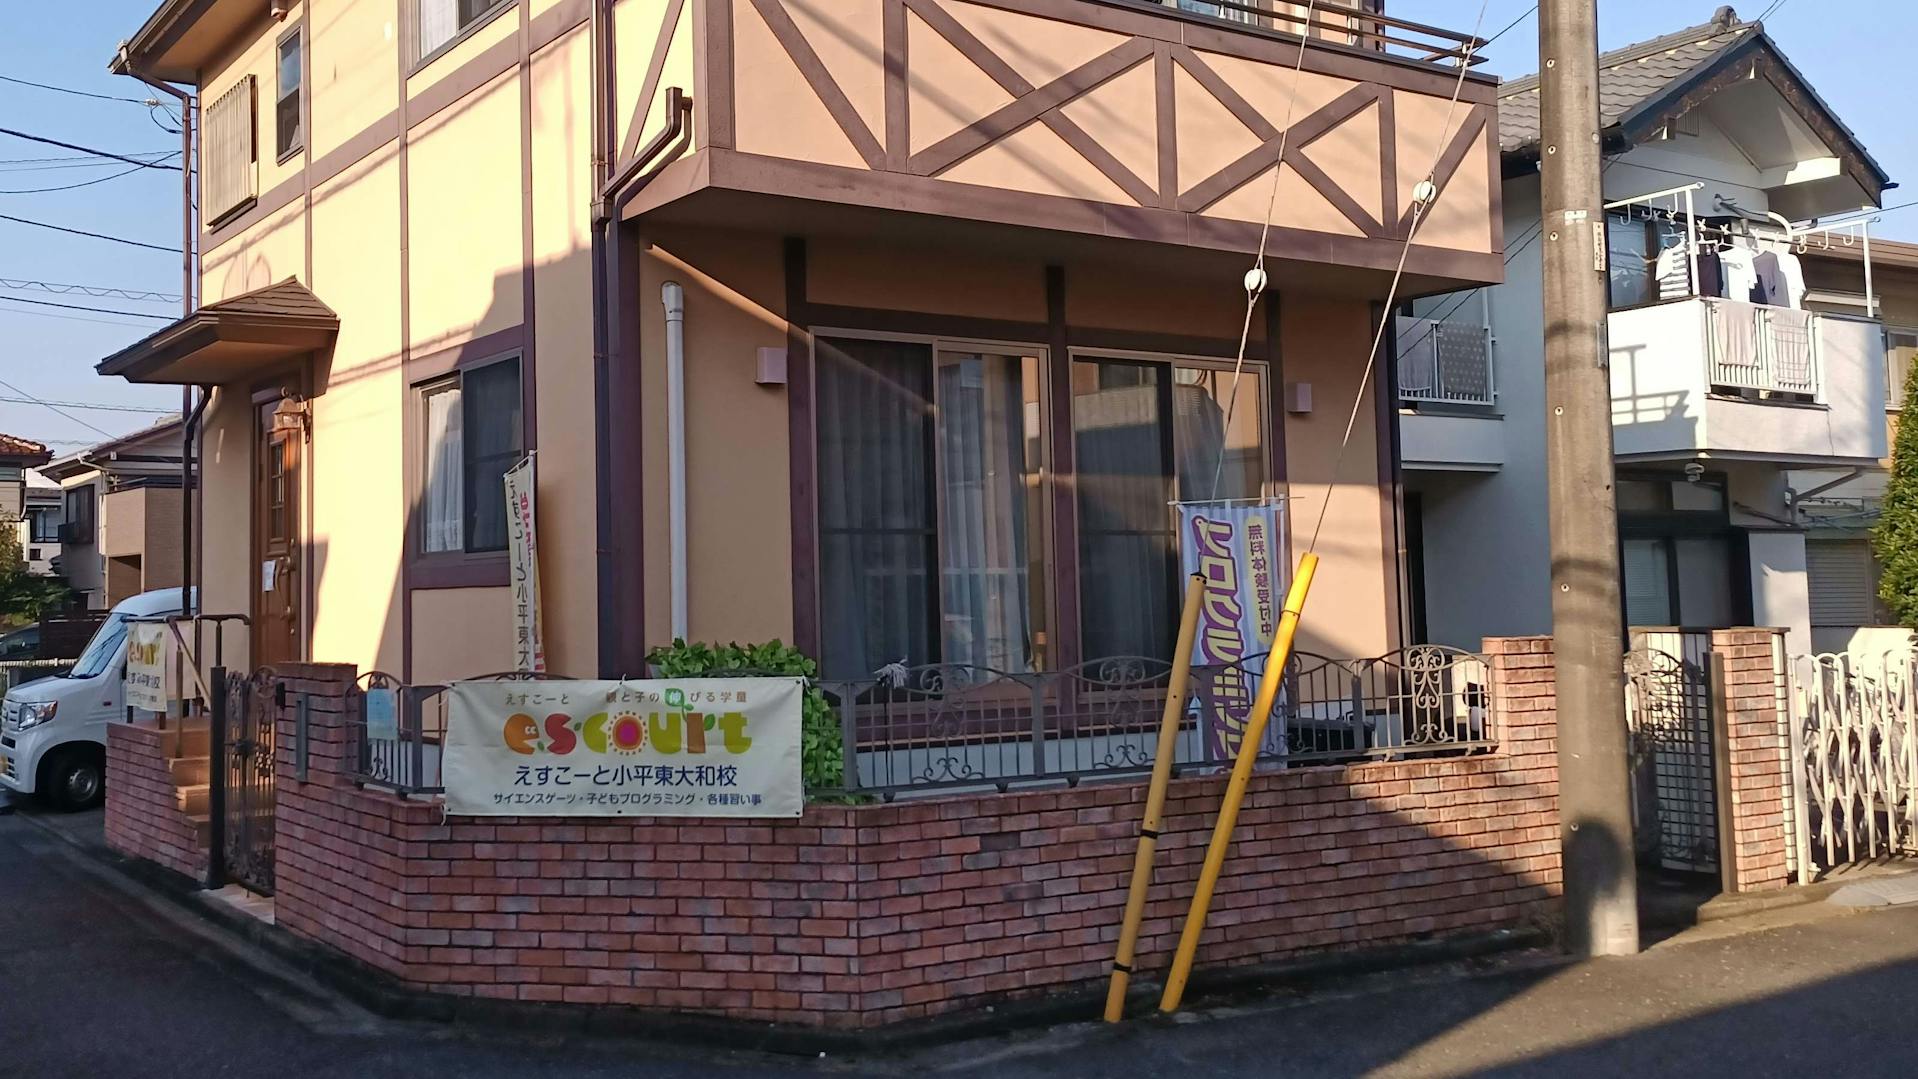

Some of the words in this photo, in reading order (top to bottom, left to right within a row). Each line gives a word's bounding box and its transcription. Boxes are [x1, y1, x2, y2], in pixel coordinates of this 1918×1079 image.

[505, 693, 569, 706] えすこーと
[503, 710, 752, 756] escourt
[514, 764, 738, 787] えすこーと小平東大和校
